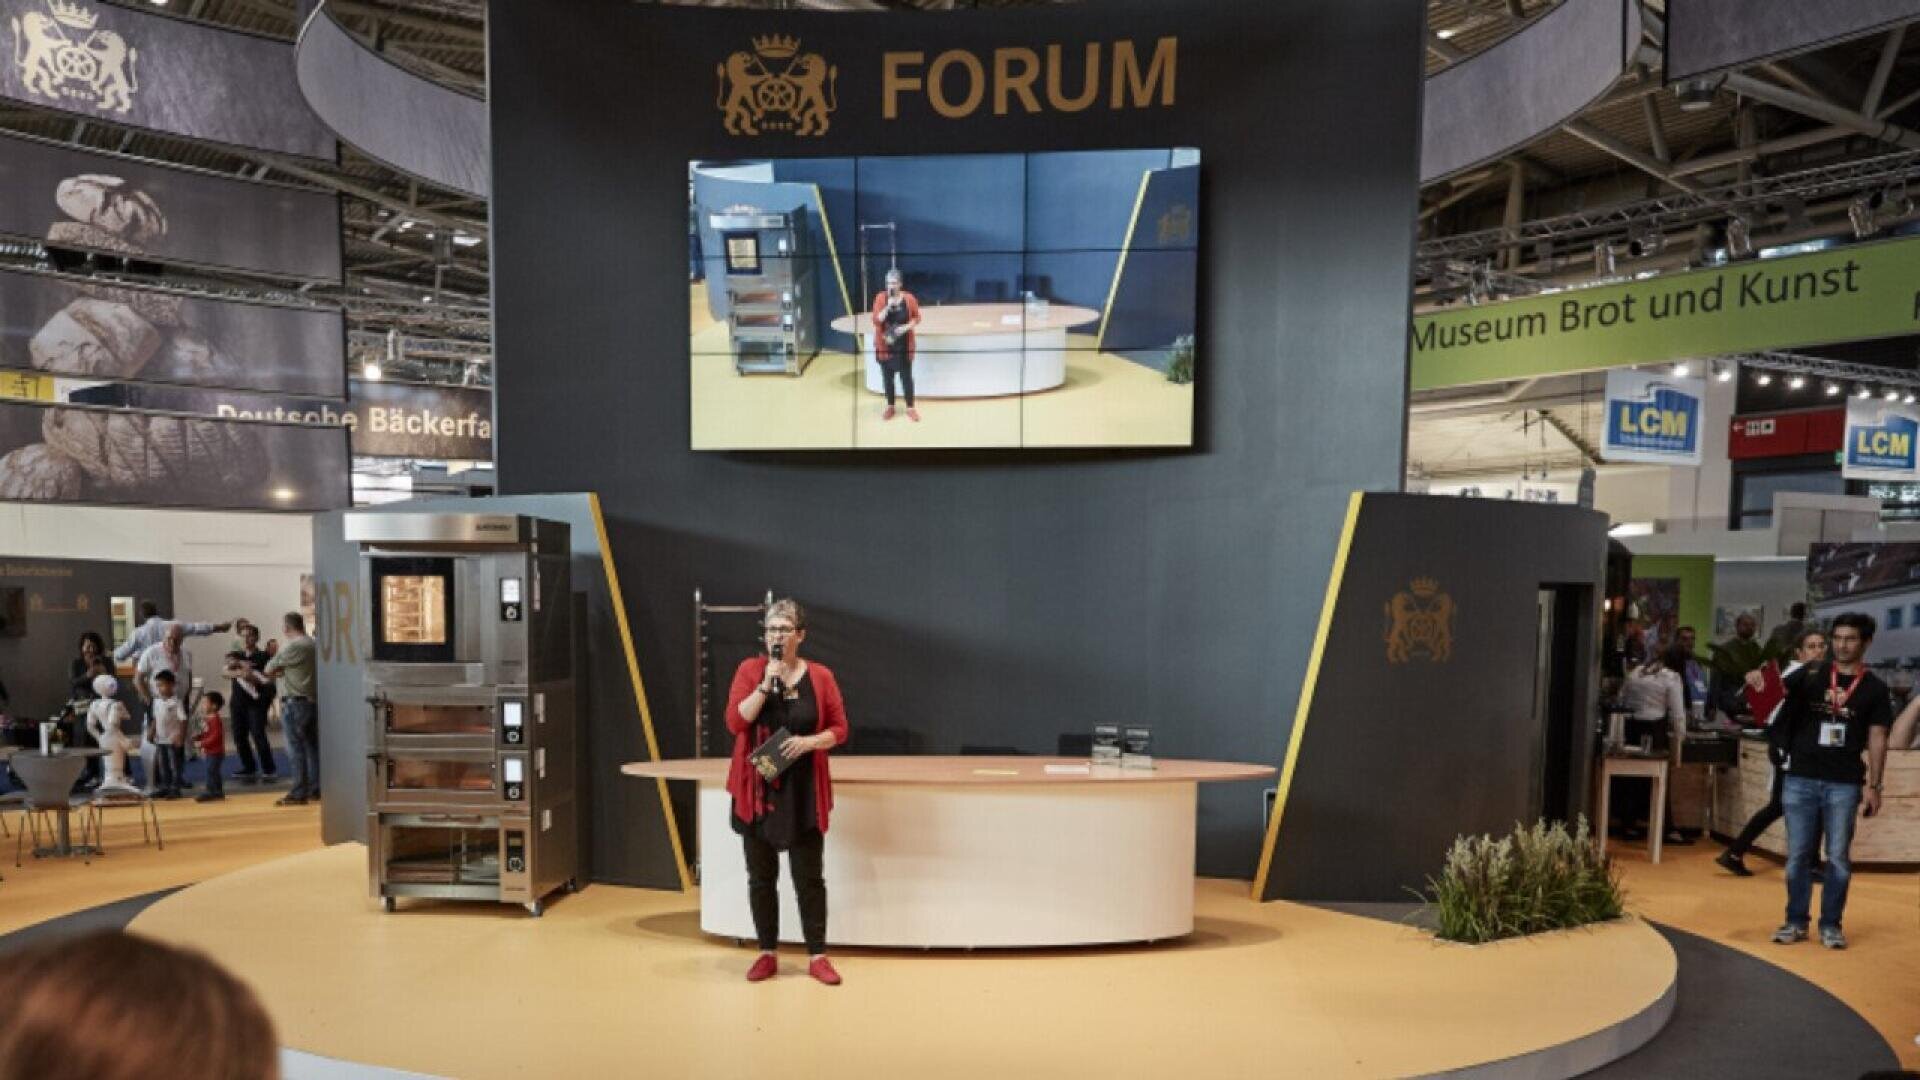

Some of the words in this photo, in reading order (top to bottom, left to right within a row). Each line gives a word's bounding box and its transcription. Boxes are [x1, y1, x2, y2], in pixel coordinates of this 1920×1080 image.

[881, 36, 1178, 119] FORUM
[1411, 311, 1547, 352] Museum
[1559, 293, 1637, 333] Brot
[1649, 275, 1725, 320] und
[1739, 259, 1861, 309] Kunst
[368, 406, 492, 439] Bäckerfa
[1620, 405, 1687, 437] LCM
[1856, 429, 1910, 458] LCM
